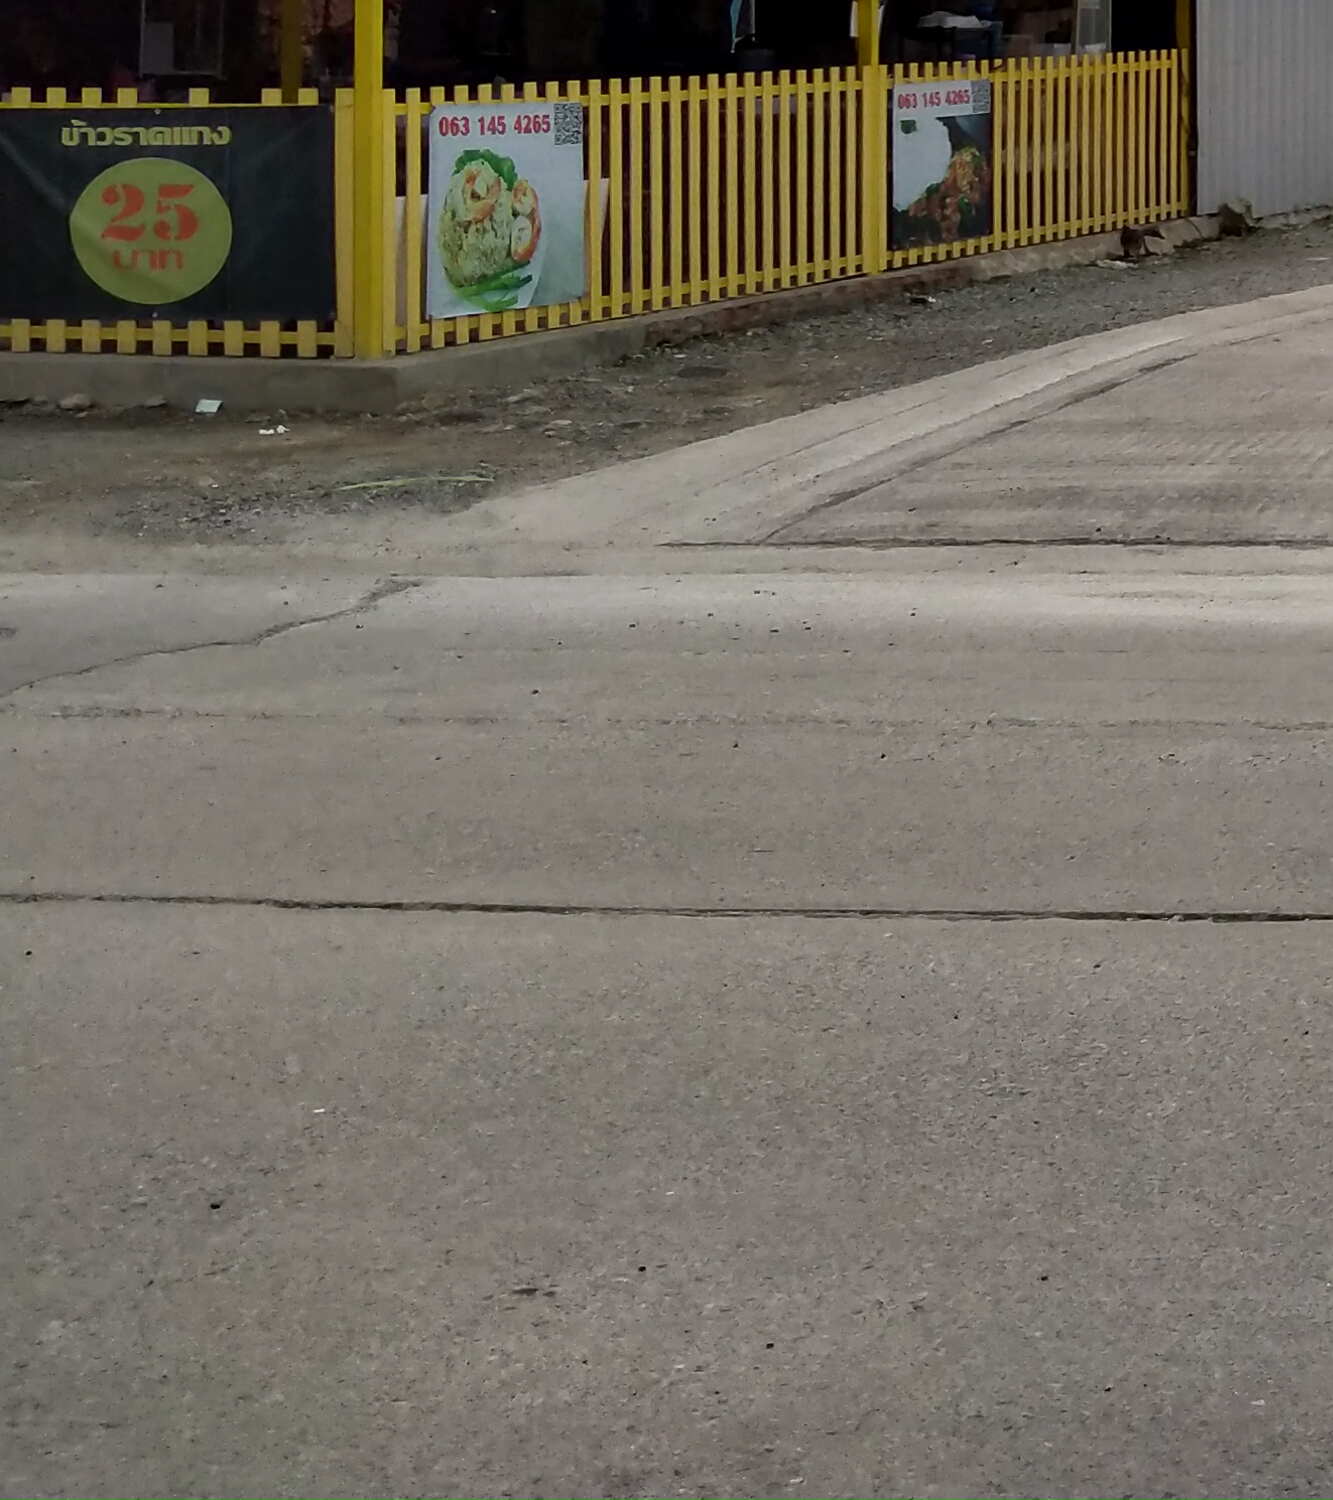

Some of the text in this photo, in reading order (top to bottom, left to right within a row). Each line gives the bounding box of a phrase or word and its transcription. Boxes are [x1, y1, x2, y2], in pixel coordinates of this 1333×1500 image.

[897, 89, 970, 109] 063 145 4265
[61, 119, 233, 146] ข้าวราดแกง
[438, 114, 551, 137] 063 145 4265
[101, 184, 200, 241] 25
[112, 249, 184, 270] บาท
